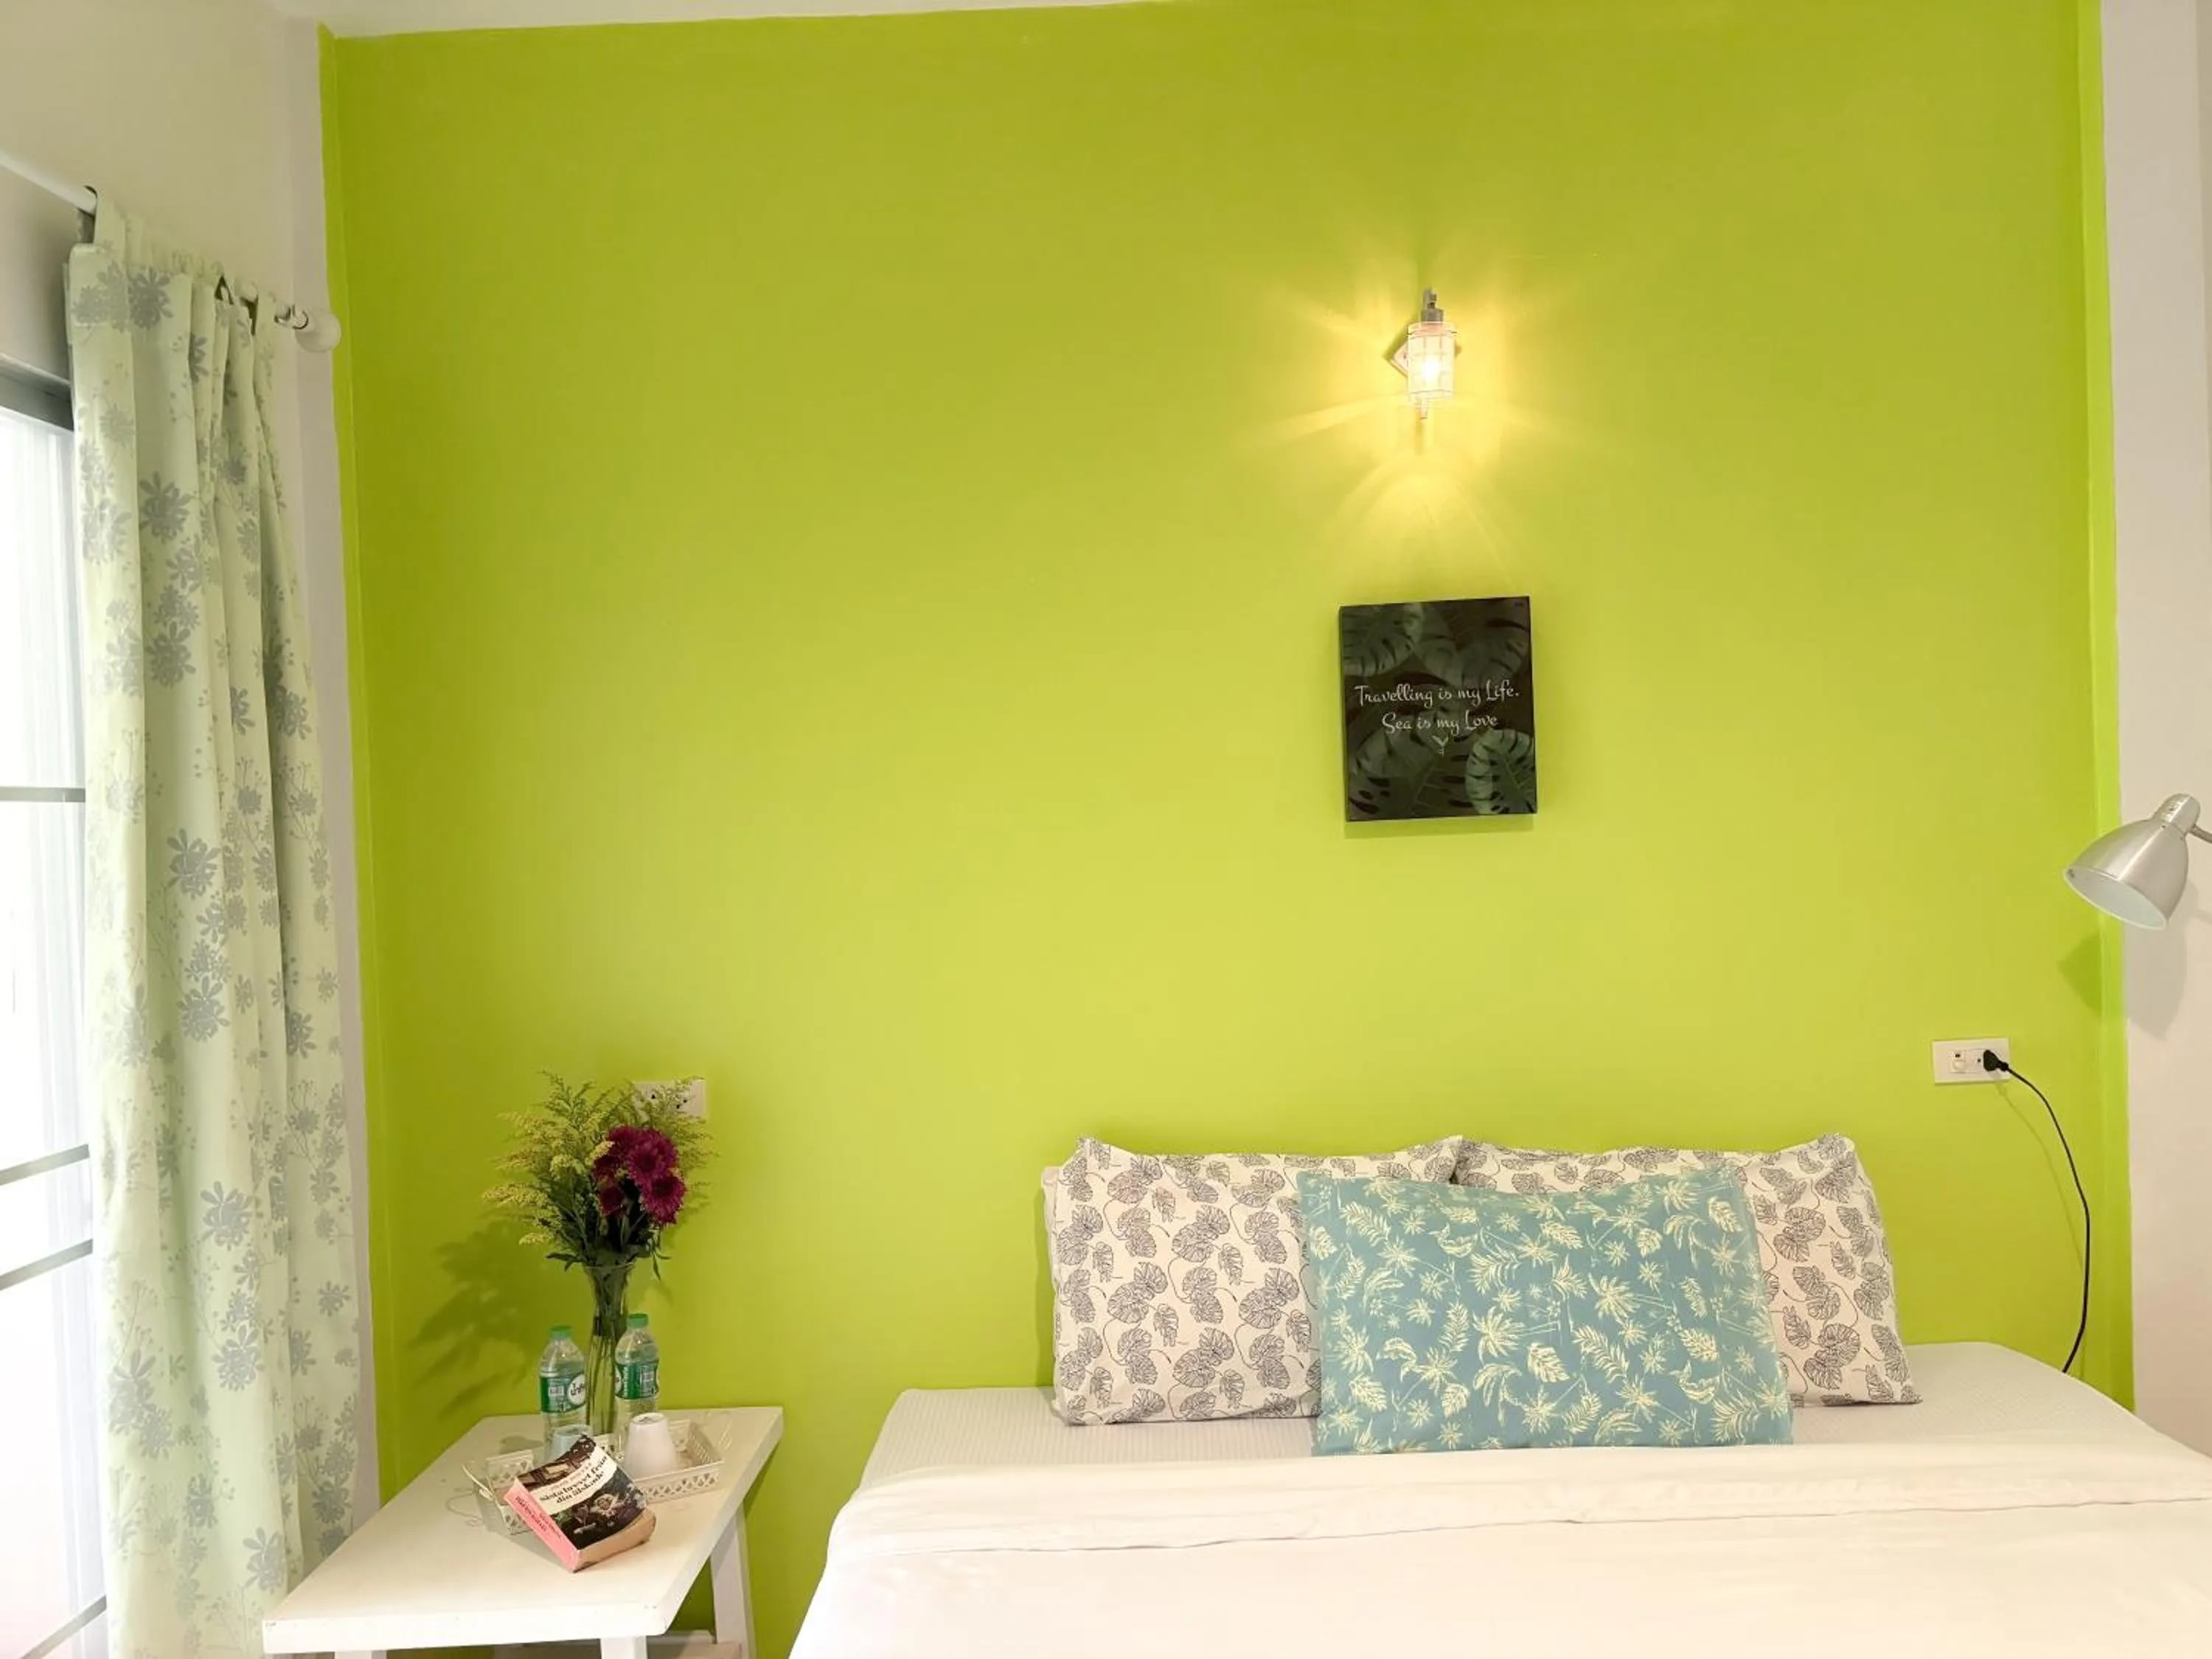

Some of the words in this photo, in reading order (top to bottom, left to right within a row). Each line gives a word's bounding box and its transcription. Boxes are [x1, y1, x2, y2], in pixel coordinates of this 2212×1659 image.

[1354, 684, 1433, 708] Travelling
[1439, 689, 1452, 700] is
[1458, 690, 1481, 706] my
[1486, 678, 1520, 702] Life.
[1382, 712, 1412, 734] Sea
[1418, 717, 1431, 729] is
[1437, 718, 1459, 736] my
[1464, 709, 1498, 731] Love
